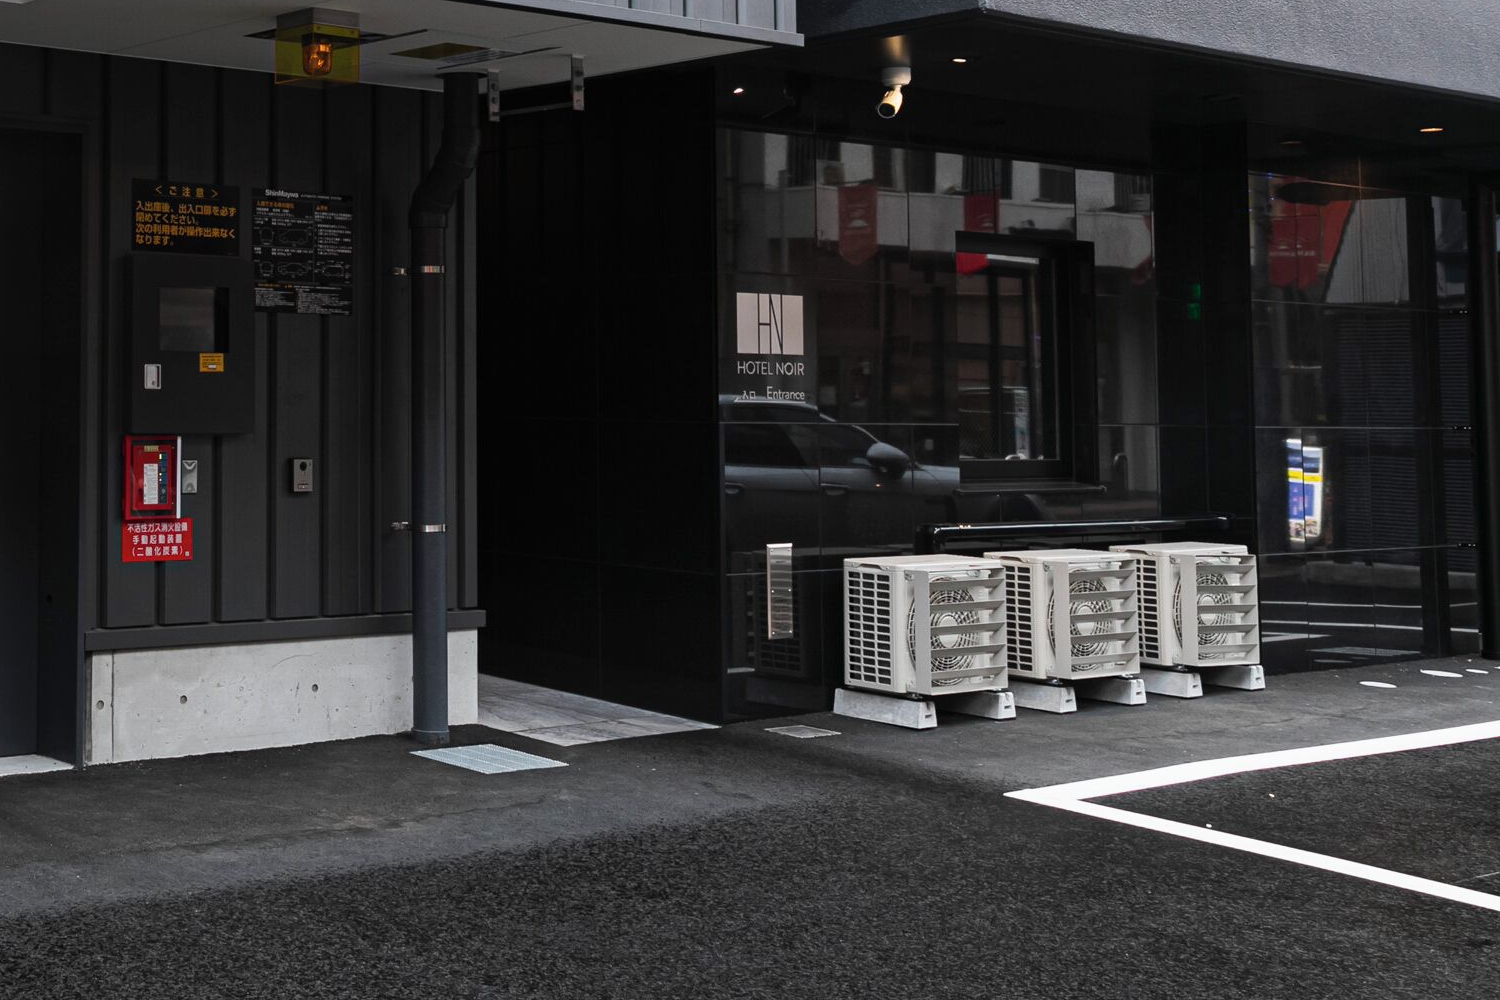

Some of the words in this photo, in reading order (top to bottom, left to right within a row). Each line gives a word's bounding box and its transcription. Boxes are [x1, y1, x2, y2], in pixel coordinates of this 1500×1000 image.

[265, 189, 299, 198] ShinMaywa
[135, 212, 199, 225] 閉めてください。
[135, 224, 236, 239] 次の利用者が操作出来なく
[135, 235, 174, 246] なります。
[737, 361, 773, 375] HOTEL
[776, 362, 805, 376] NOIR
[742, 390, 756, 400] 入口
[766, 386, 805, 400] Entrance
[127, 522, 188, 533] 不活性ガス消火設備
[132, 534, 183, 545] 手動起動装置
